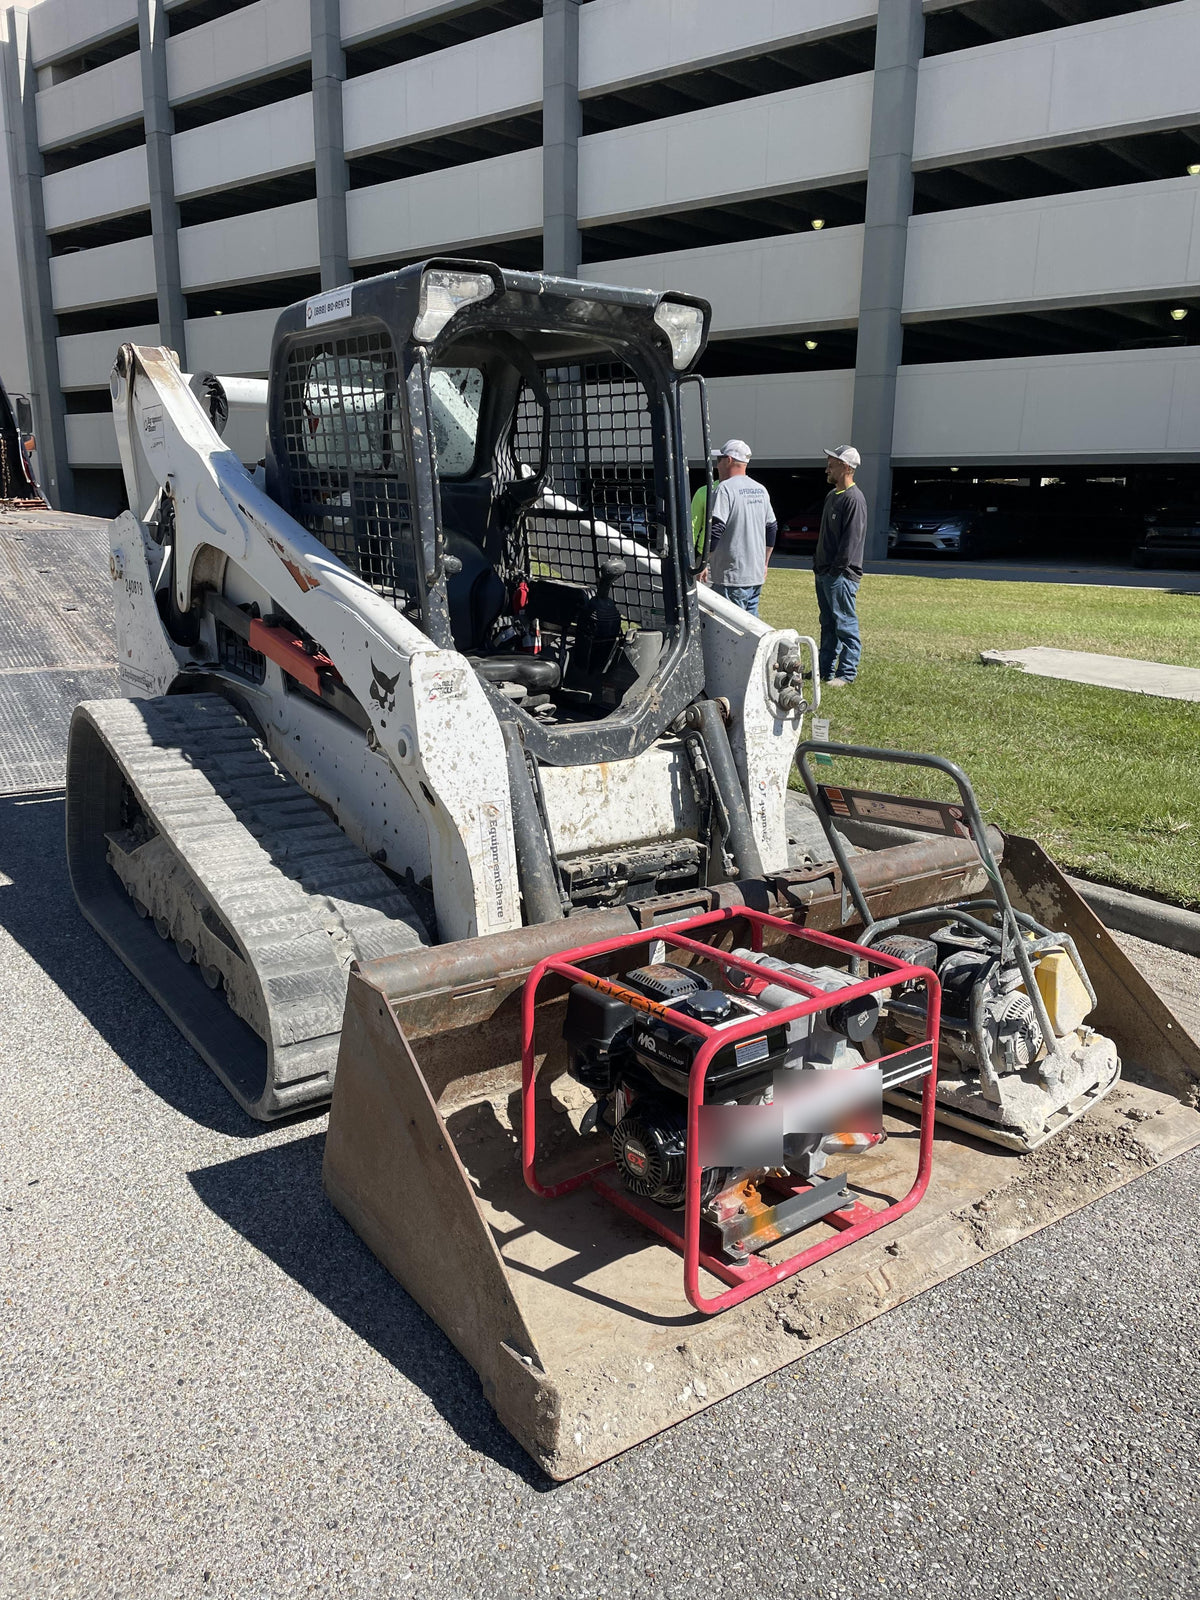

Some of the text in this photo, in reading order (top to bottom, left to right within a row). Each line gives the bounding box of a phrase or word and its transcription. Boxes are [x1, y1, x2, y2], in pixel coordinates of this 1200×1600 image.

[488, 819, 505, 918] EquipmentShare
[637, 1032, 657, 1053] MQ
[627, 1152, 645, 1169] GX
